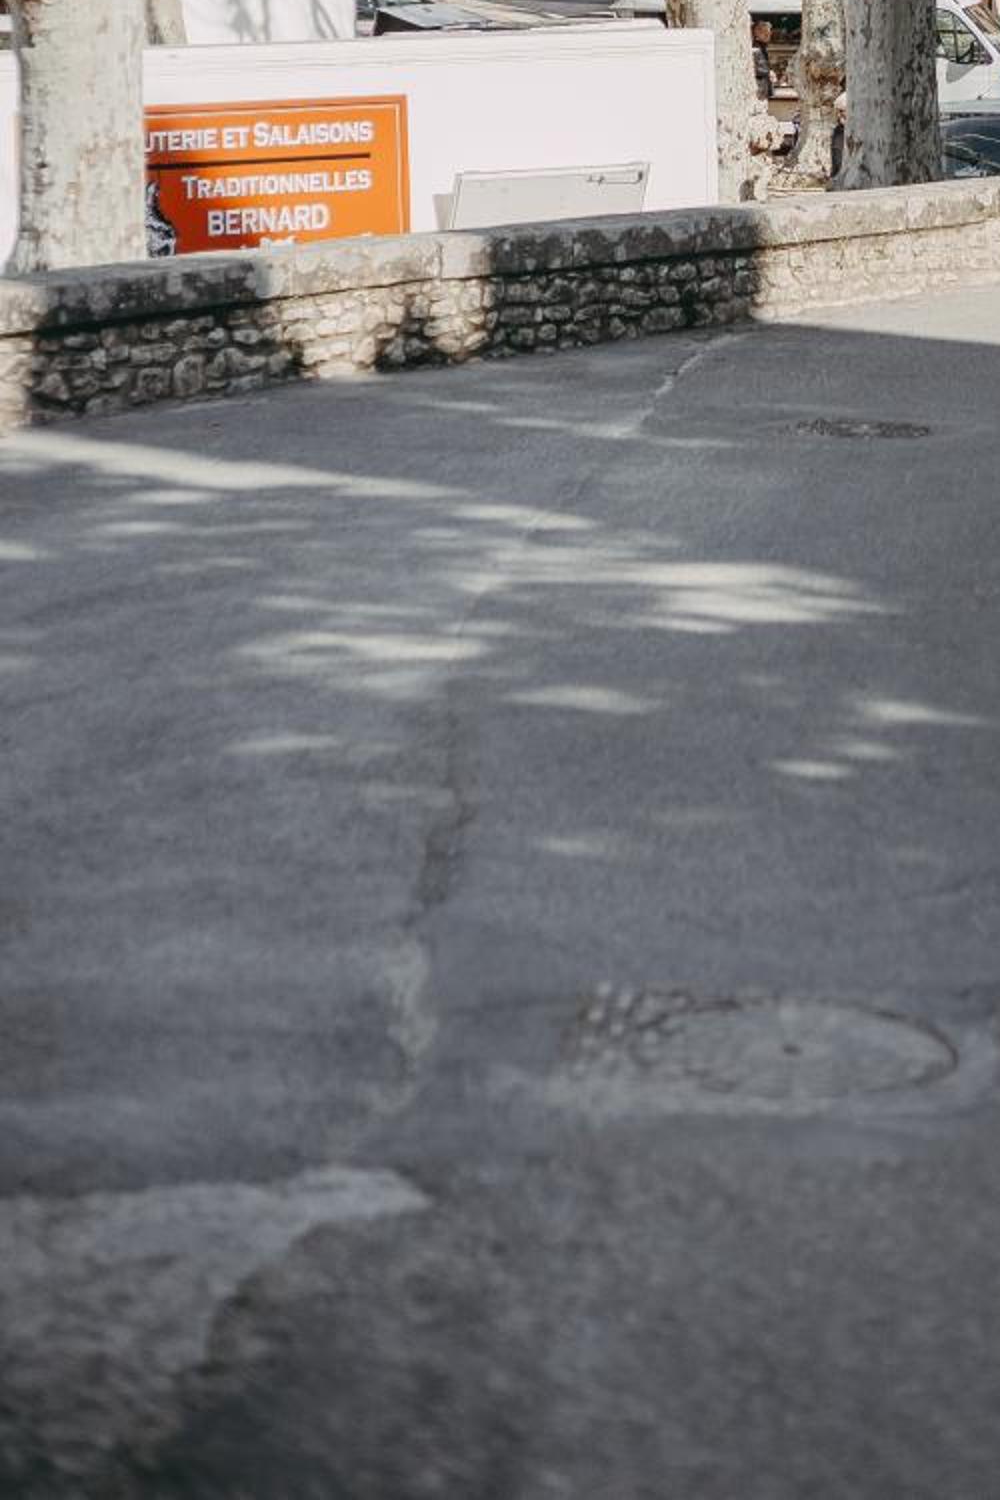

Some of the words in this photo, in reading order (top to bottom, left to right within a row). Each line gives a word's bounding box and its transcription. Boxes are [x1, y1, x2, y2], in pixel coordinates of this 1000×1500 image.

[222, 126, 249, 149] ET
[253, 122, 373, 147] SALAISONS
[182, 170, 372, 199] TRADITIONNELLES
[207, 204, 329, 236] BERNARD
